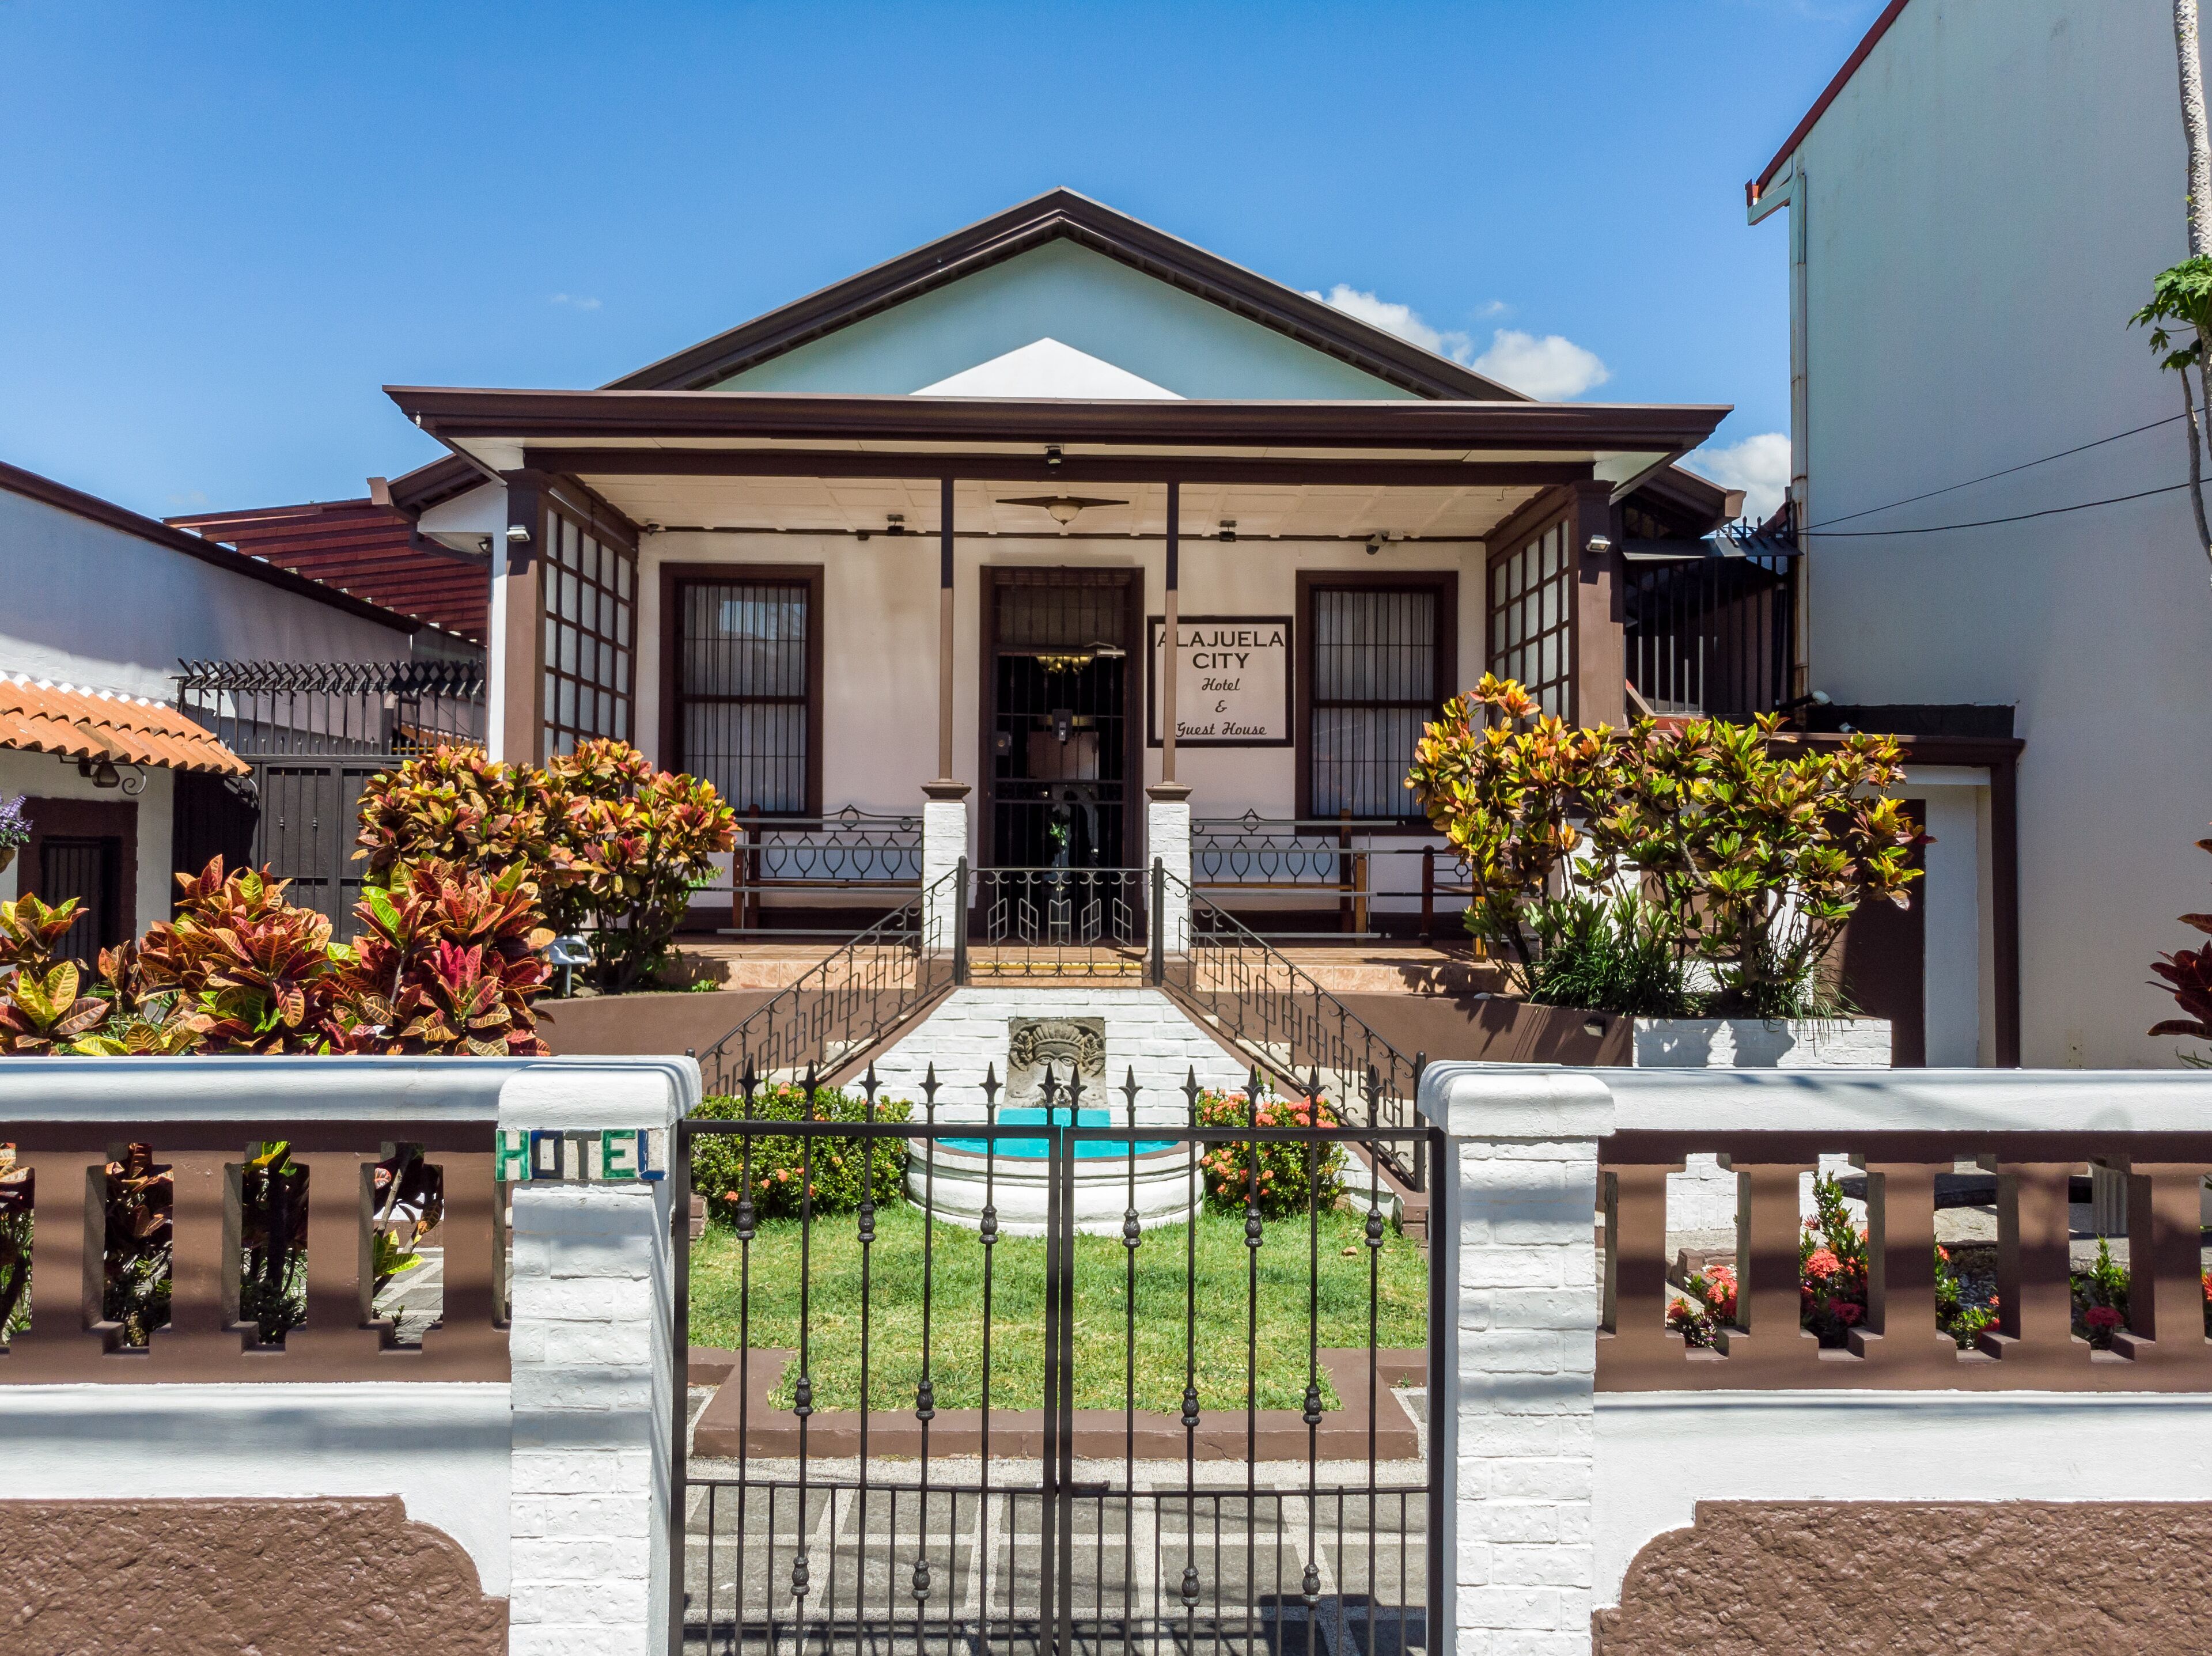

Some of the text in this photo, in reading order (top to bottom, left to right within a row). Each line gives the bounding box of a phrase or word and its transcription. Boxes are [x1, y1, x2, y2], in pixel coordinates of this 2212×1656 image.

[1192, 653, 1250, 669] CITY
[1202, 677, 1240, 691] Hotel
[1215, 699, 1228, 713] &
[1176, 722, 1267, 738] Guest House
[495, 1128, 666, 1181] HOTEL
